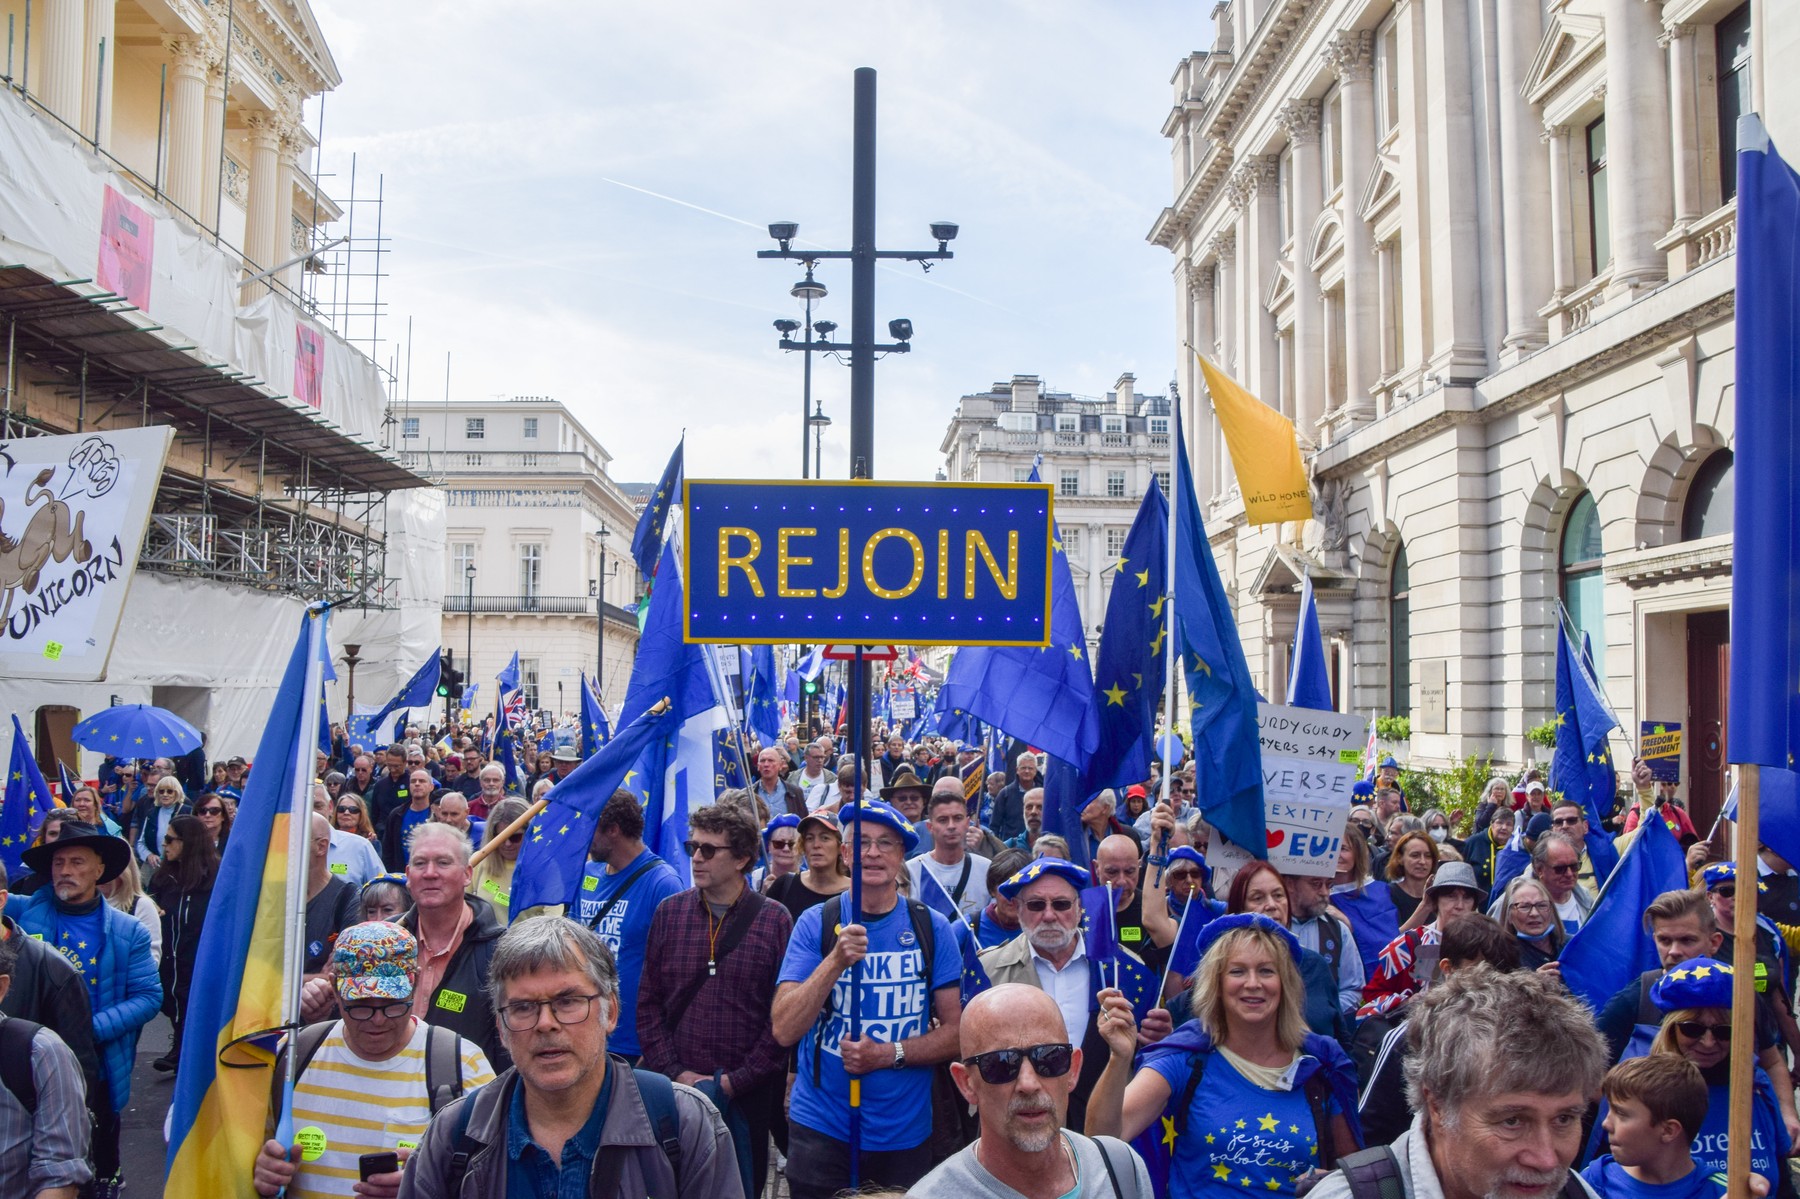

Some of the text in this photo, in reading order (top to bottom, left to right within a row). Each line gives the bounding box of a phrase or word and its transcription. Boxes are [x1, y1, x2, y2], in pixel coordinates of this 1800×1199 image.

[1248, 490, 1309, 504] WILD HONE
[718, 526, 1019, 600] REJOIN
[7, 534, 123, 640] UNICORN
[1258, 716, 1352, 741] URDY GURDY
[1259, 737, 1336, 759] AYERS SAY
[1641, 743, 1680, 757] MOVEMENT
[1642, 735, 1673, 747] FREEDOM
[1262, 769, 1346, 793] VERSE
[1271, 803, 1333, 823] EXIT!
[1289, 832, 1340, 859] EU!
[831, 982, 926, 1017] OR THE
[1227, 1130, 1295, 1153] je suis
